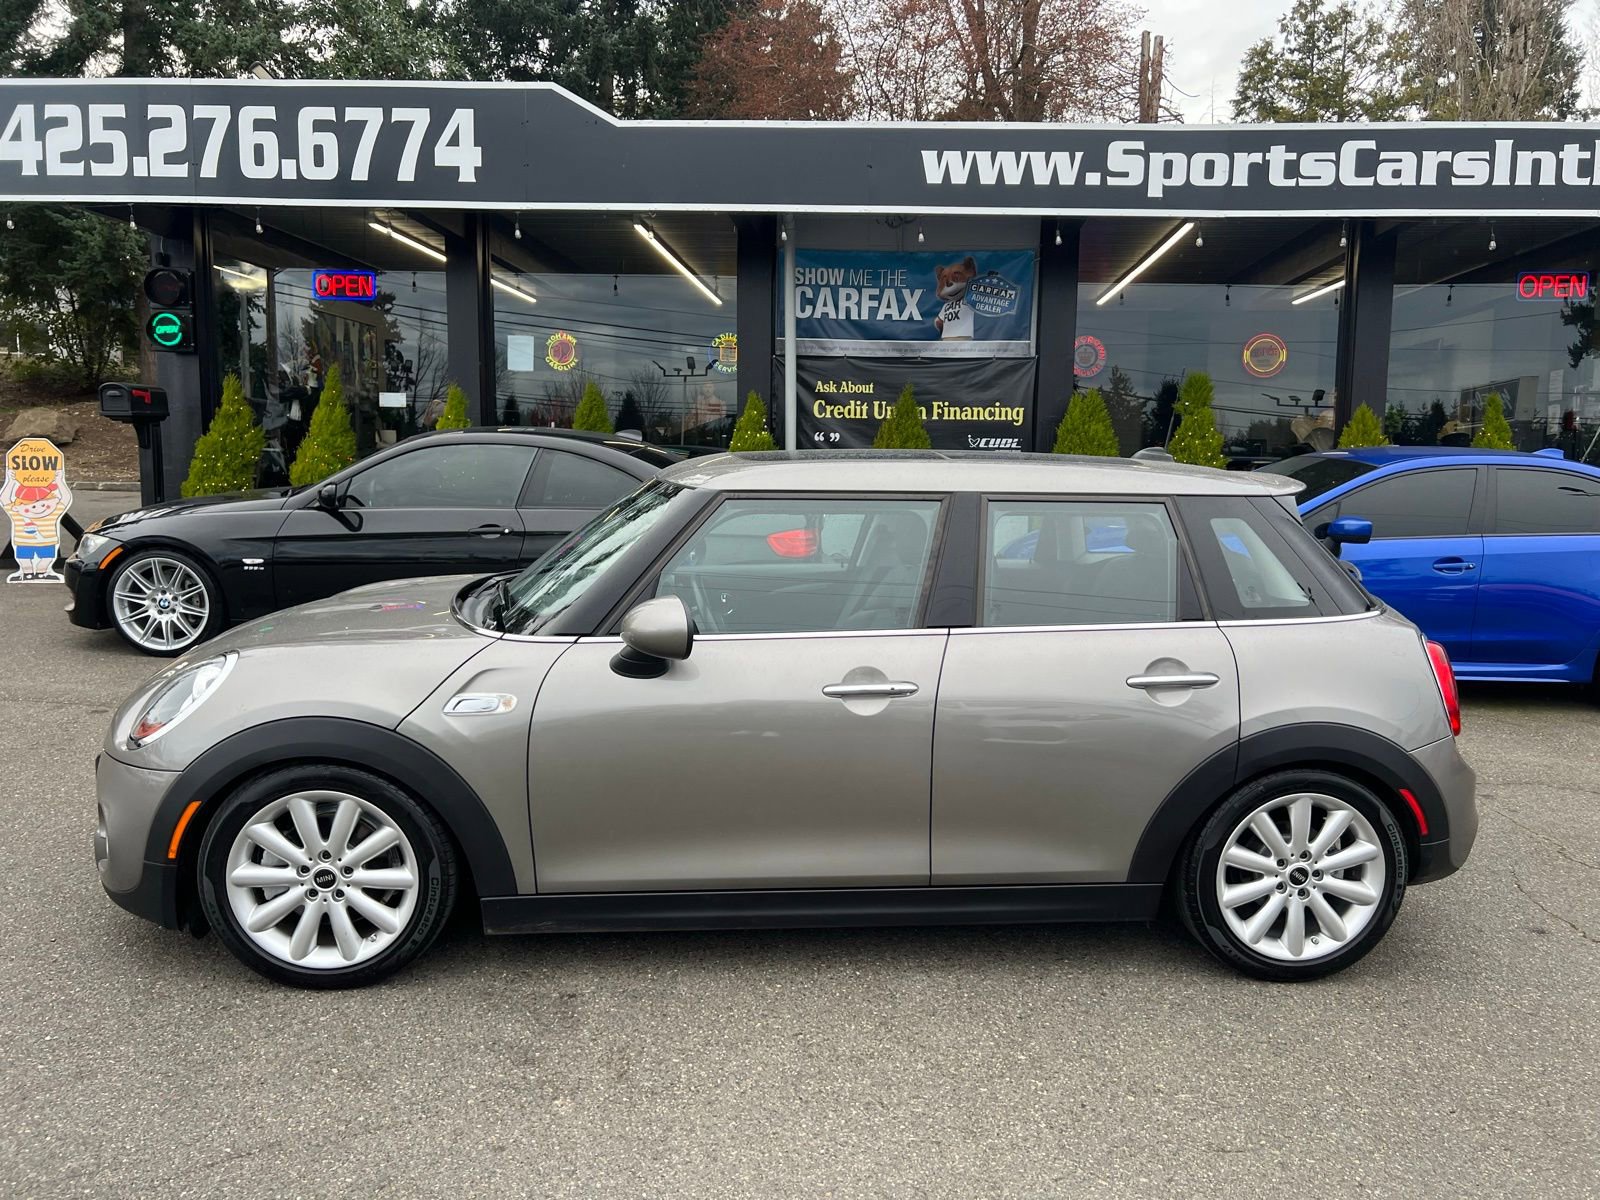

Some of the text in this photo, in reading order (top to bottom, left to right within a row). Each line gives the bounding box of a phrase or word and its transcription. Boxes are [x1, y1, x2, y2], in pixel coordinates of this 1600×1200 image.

[0, 104, 482, 183] 425.276.6774
[794, 267, 907, 287] SHOW ME THE
[316, 274, 373, 297] OPEN
[971, 284, 1015, 300] CARFAX
[1519, 275, 1587, 298] OPEN
[794, 286, 923, 321] CARFAX
[971, 293, 1011, 308] ADVANTAGE
[975, 302, 1002, 314] DEALER
[944, 310, 961, 323] FOX
[155, 325, 180, 335] OPEN
[545, 356, 579, 371] GASOLINE
[814, 380, 874, 394] Ask About
[813, 399, 1026, 427] Credit Unn Financing
[20, 443, 46, 453] Drive
[11, 455, 59, 471] SLOW
[22, 473, 50, 484] please
[316, 874, 334, 884] MINI
